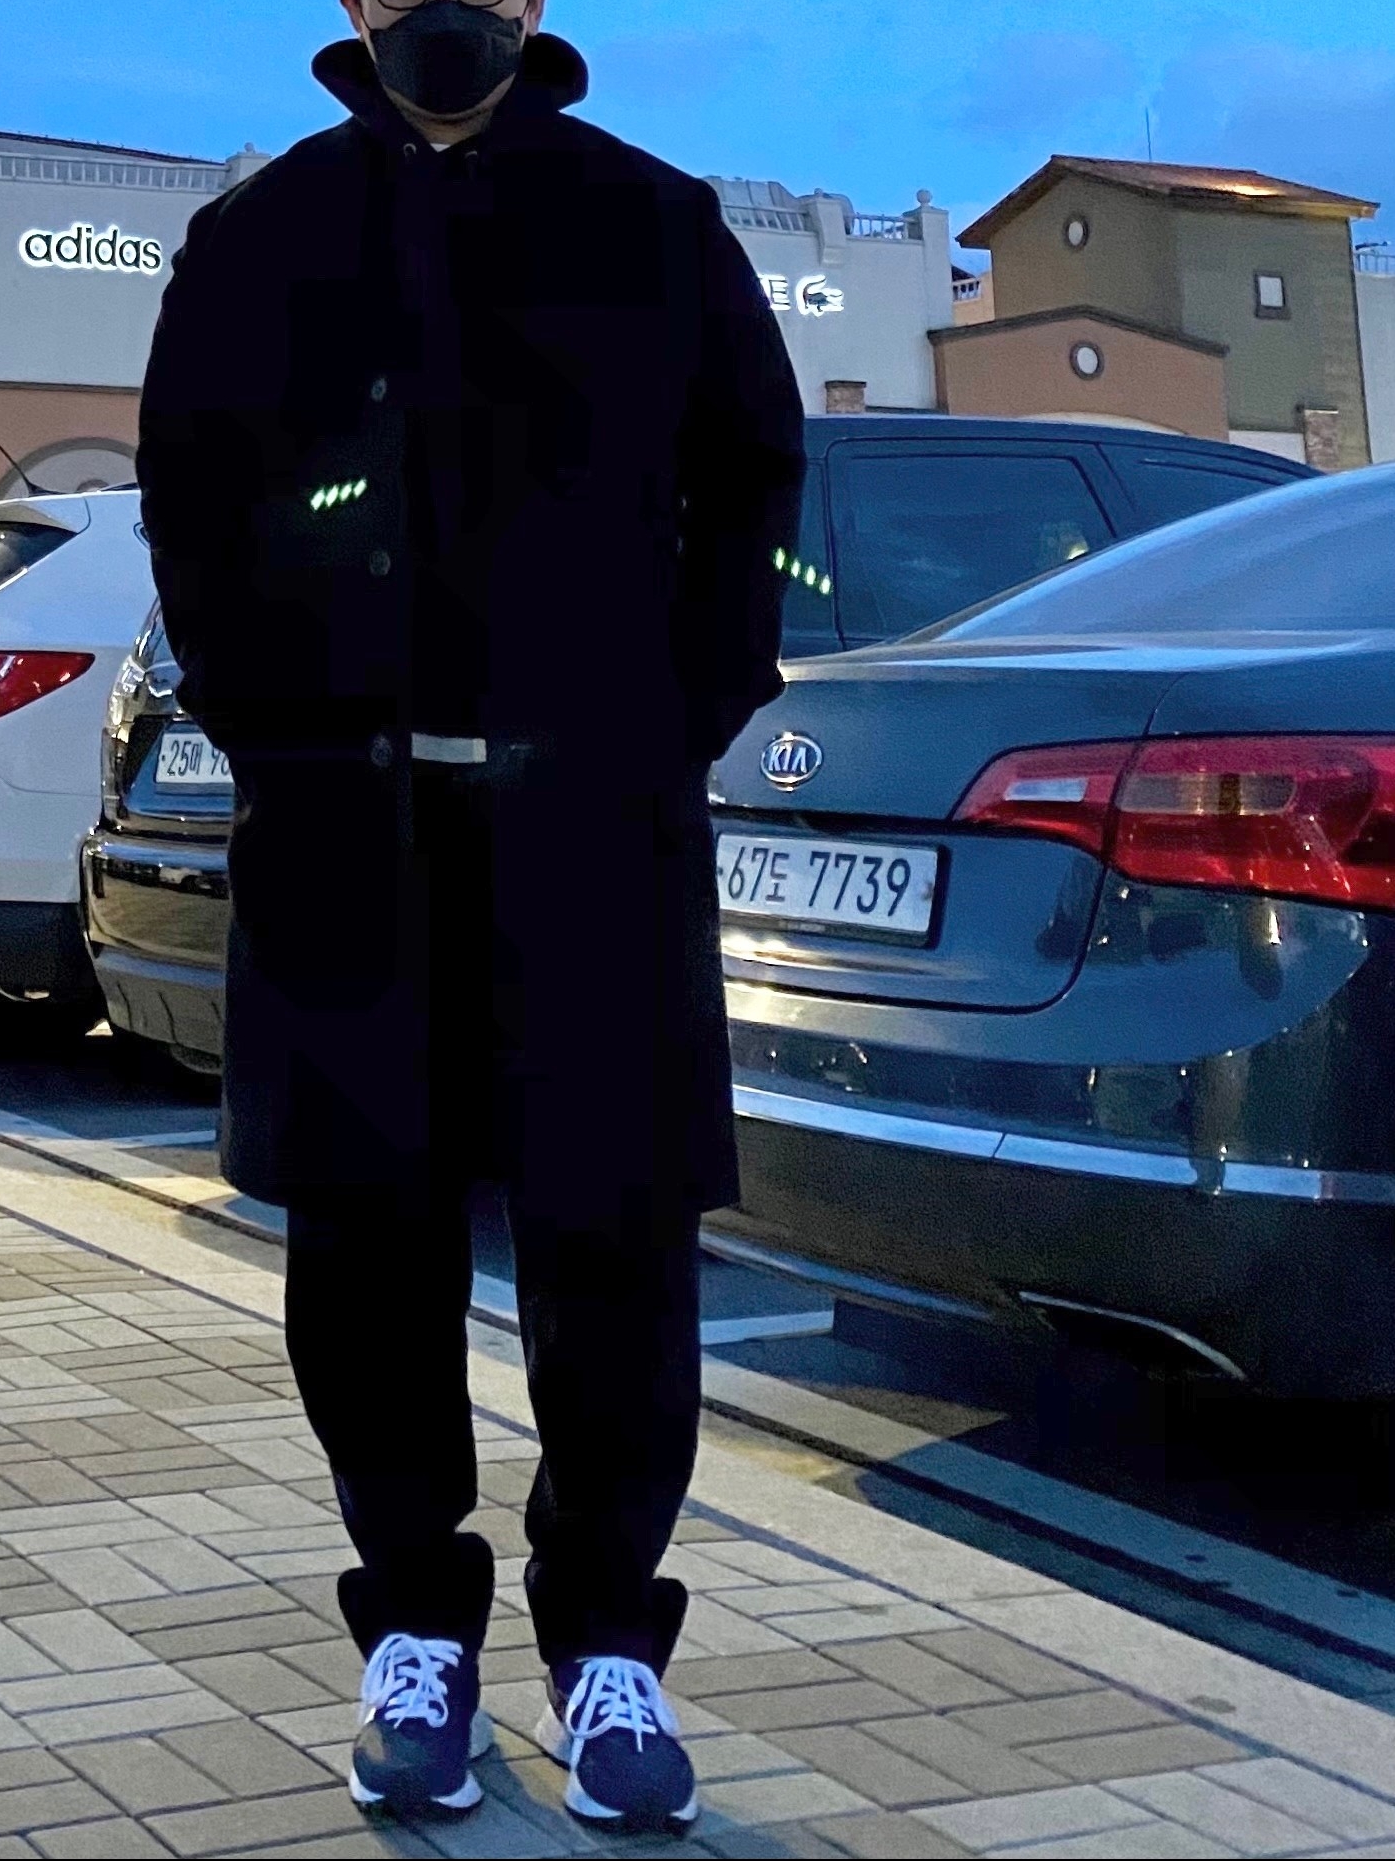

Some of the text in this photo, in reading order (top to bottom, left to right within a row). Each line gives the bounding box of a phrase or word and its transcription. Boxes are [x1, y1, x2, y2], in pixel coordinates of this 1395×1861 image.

[24, 226, 162, 270] adidas
[768, 744, 808, 773] KIA
[728, 846, 912, 918] 67도 7739
